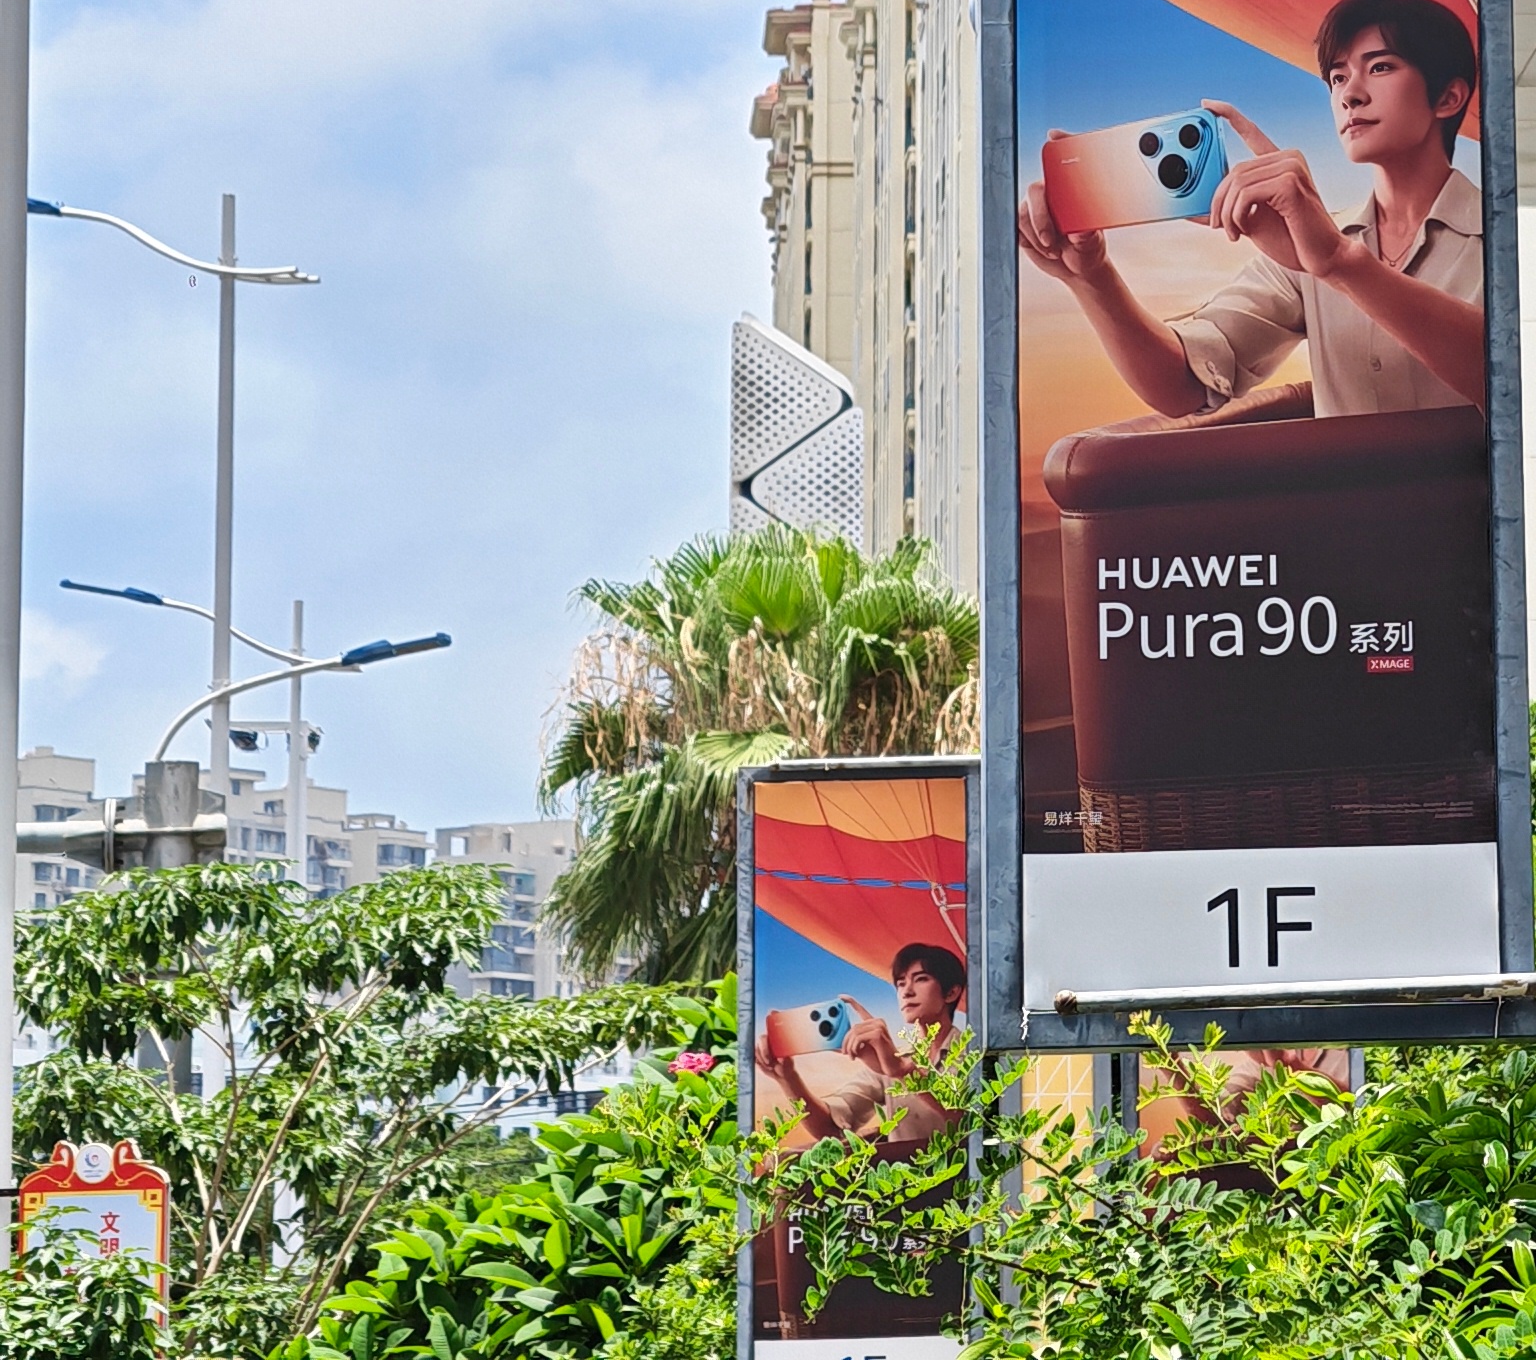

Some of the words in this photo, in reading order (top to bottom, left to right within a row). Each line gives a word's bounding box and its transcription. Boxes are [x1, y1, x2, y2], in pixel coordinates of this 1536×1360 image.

[1098, 554, 1277, 590] HUAWEI
[1349, 620, 1413, 653] 系列
[1370, 659, 1410, 669] XMAGE
[1207, 886, 1316, 968] 1F
